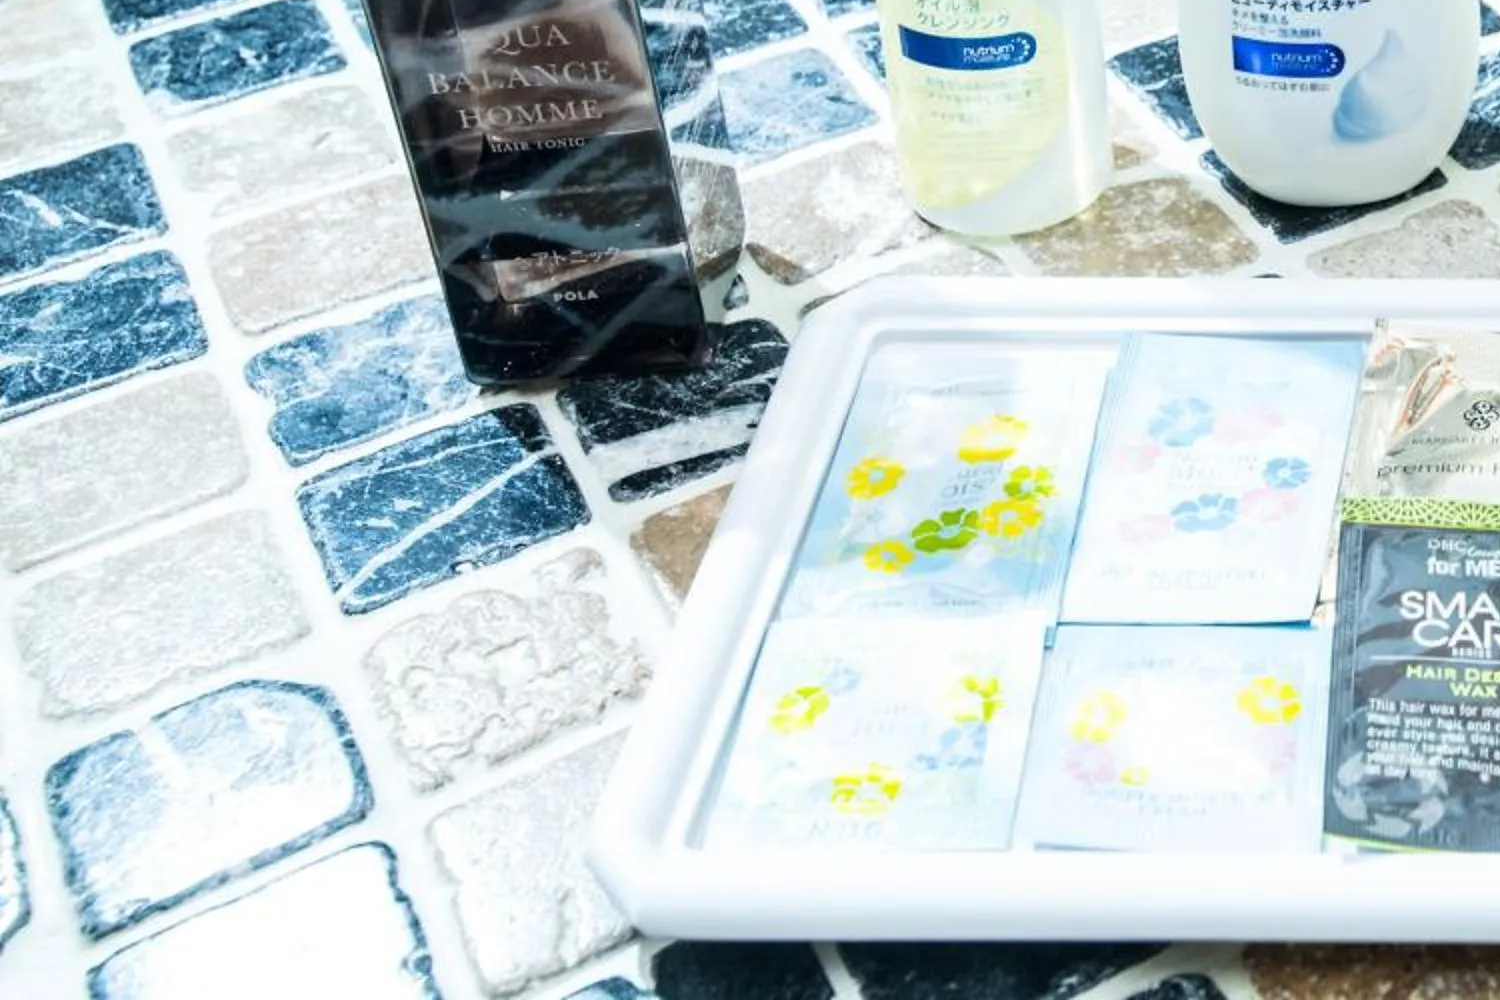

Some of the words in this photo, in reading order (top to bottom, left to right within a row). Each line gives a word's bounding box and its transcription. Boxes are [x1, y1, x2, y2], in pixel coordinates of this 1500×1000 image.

[963, 43, 1015, 57] nutrium
[427, 59, 616, 95] BALANCE
[458, 98, 604, 130] HOMME
[490, 138, 530, 154] HAIR
[535, 136, 586, 152] TONIC
[553, 289, 600, 302] POLA
[1376, 461, 1484, 479] premium
[1427, 554, 1461, 576] for
[1368, 698, 1395, 713] This
[1400, 700, 1425, 715] hair
[1428, 703, 1455, 717] wax
[1459, 703, 1478, 717] for
